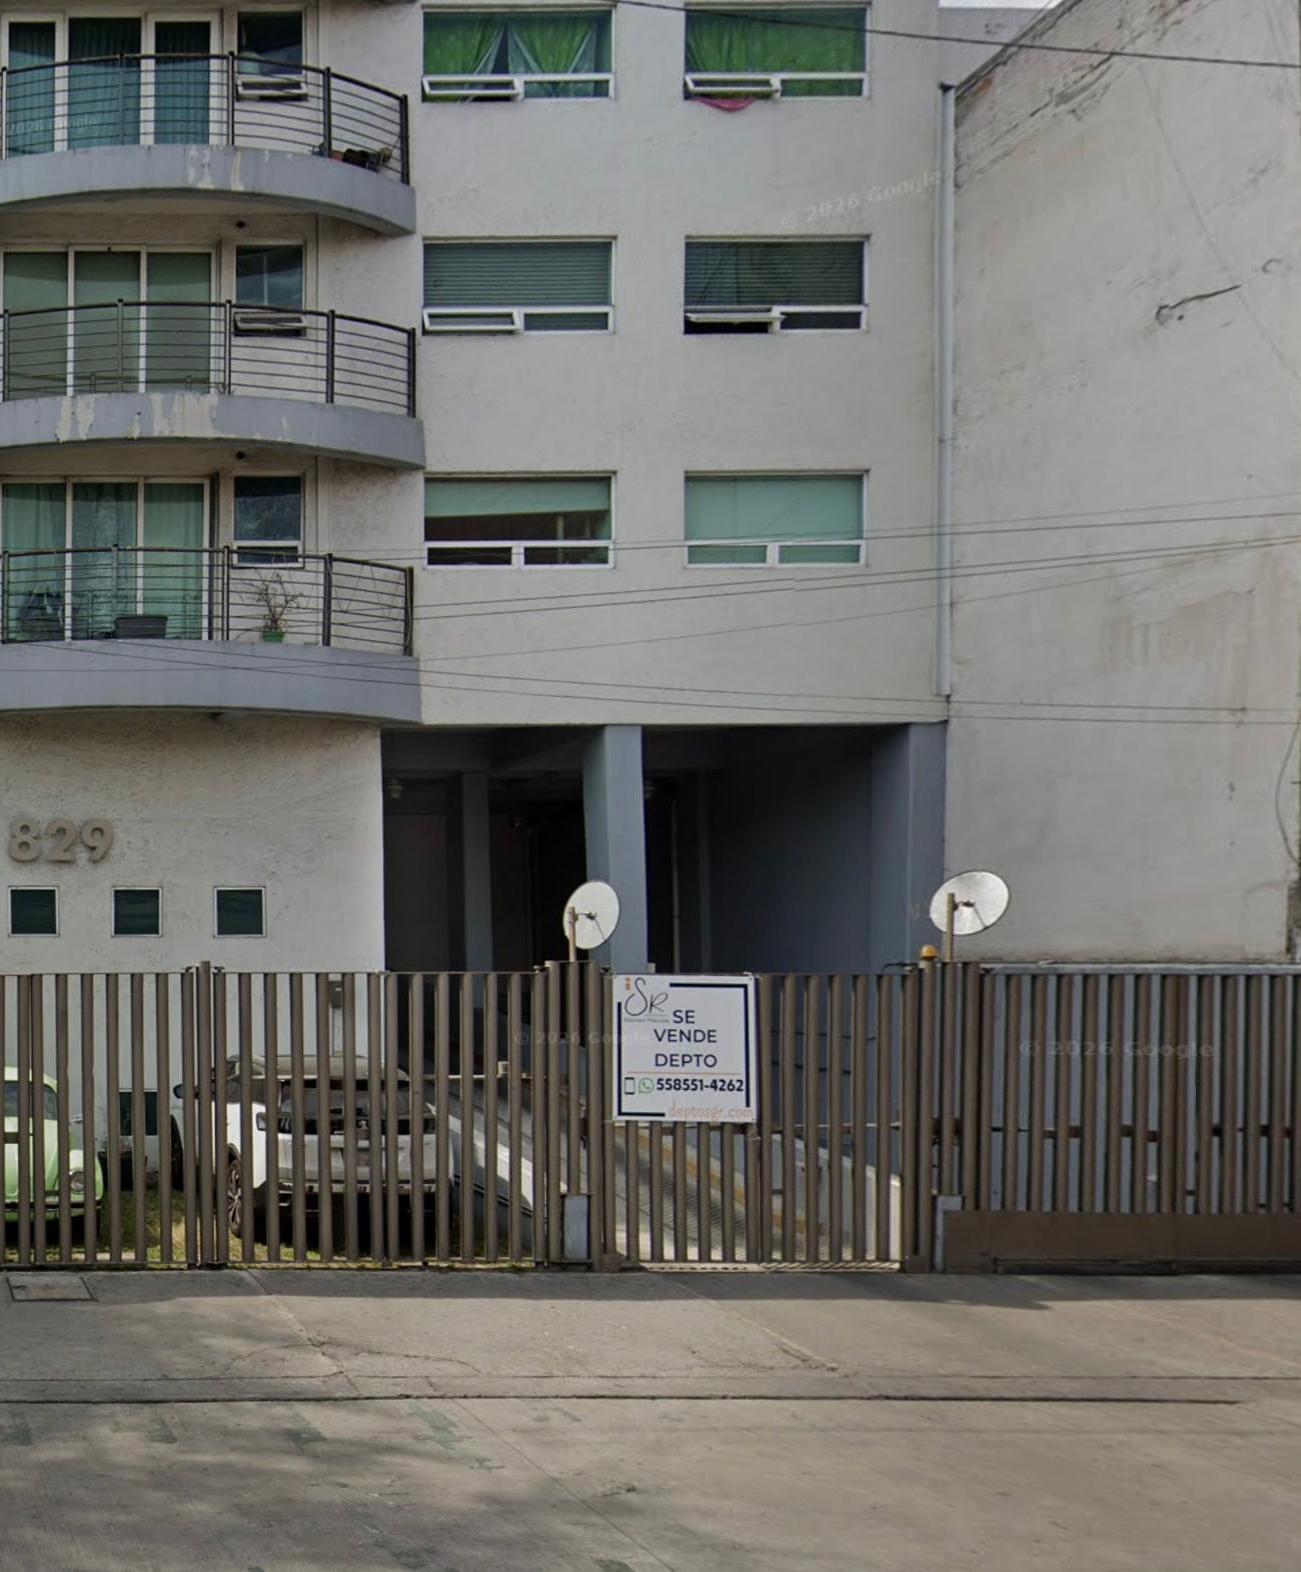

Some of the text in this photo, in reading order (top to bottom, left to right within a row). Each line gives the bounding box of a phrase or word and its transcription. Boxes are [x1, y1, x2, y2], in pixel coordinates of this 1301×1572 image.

[9, 818, 115, 863] 829
[673, 1010, 695, 1023] SE
[654, 1029, 717, 1043] VENDE
[655, 1053, 717, 1067] DEPTO
[656, 1078, 744, 1092] 558551-4262
